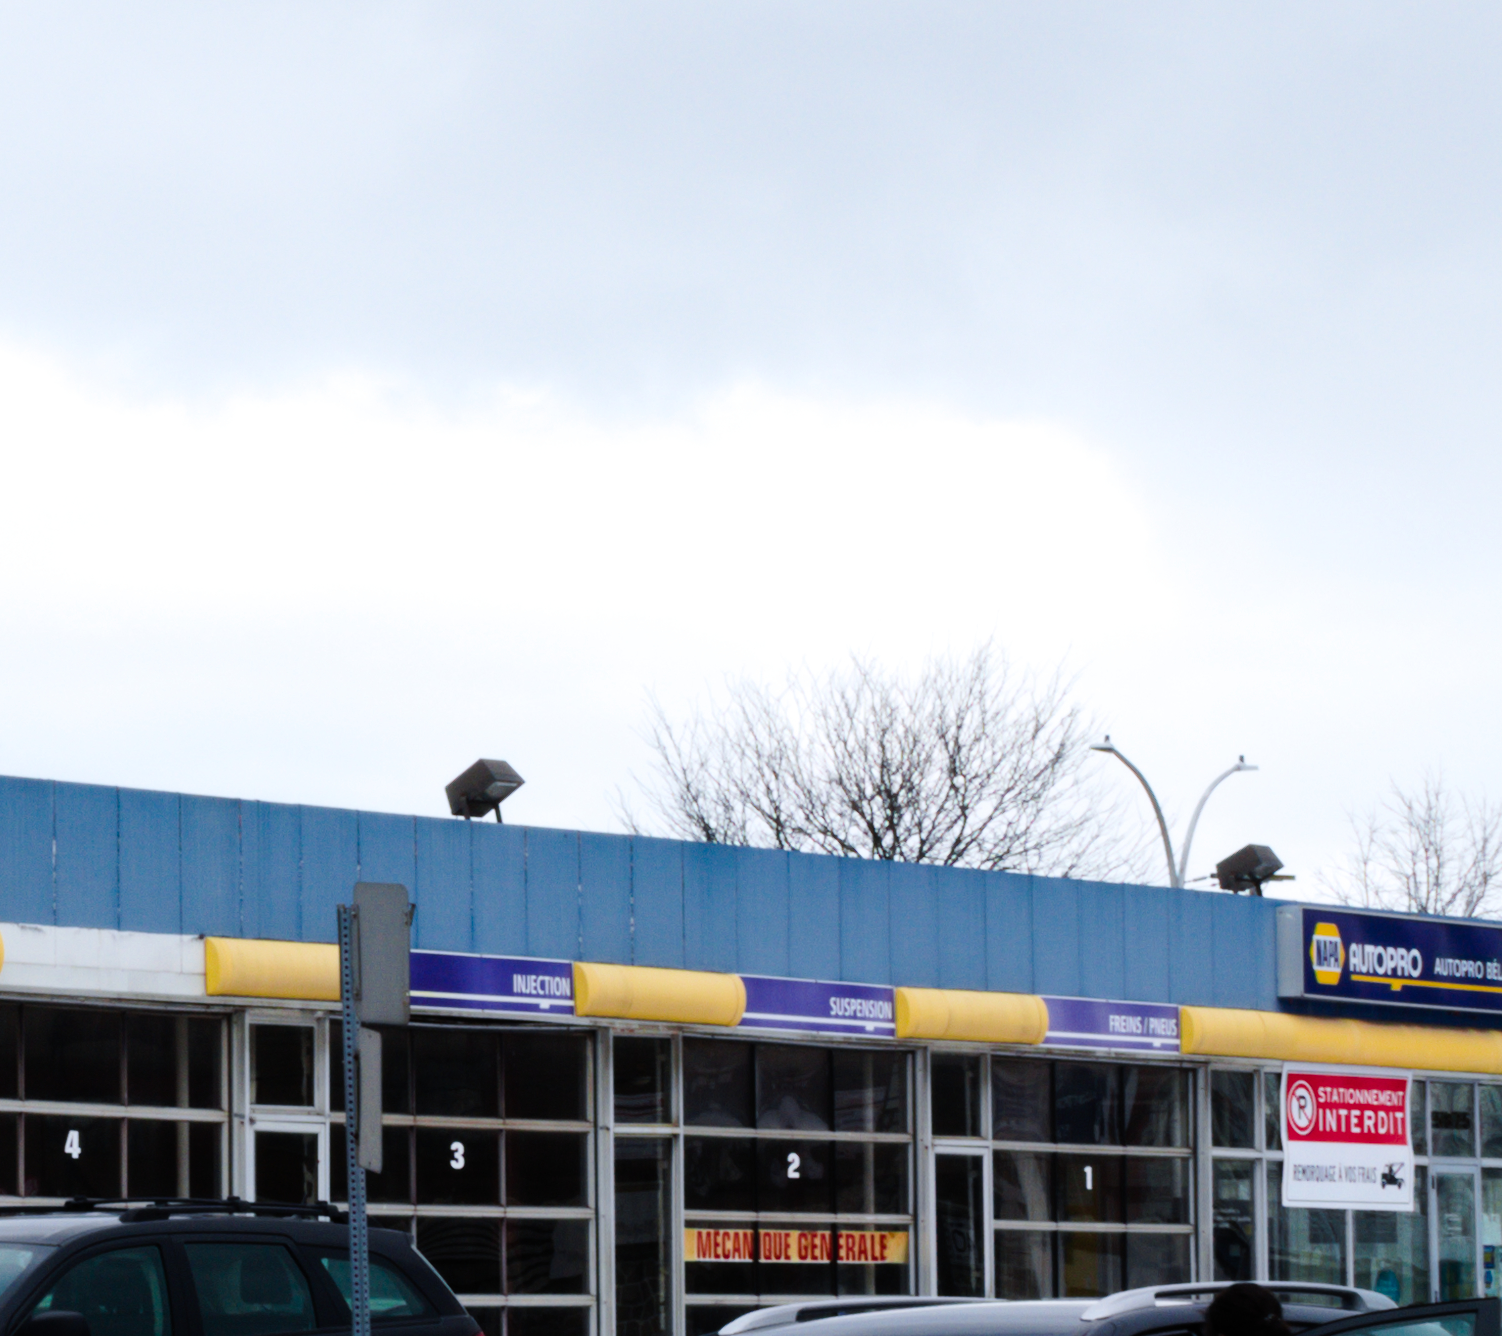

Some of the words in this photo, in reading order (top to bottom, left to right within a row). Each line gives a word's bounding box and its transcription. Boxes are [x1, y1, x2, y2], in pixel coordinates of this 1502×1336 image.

[1315, 938, 1342, 970] NAPA
[1349, 942, 1423, 979] AUTOPRO
[1434, 957, 1484, 980] AUTOPRO
[512, 972, 572, 999] INJECTION
[829, 996, 893, 1021] SUSPENSION
[1108, 1014, 1142, 1035] FREINS
[1148, 1016, 1179, 1038] PNEUS
[1317, 1086, 1405, 1107] STATIONNEMENT
[1318, 1108, 1405, 1136] INTERDIT
[63, 1129, 82, 1159] 4
[449, 1141, 466, 1170] 3
[786, 1152, 801, 1180] 2
[1083, 1165, 1094, 1191] 1
[1292, 1164, 1337, 1184] REMORQUAGE
[1344, 1165, 1357, 1183] VOS
[1357, 1166, 1377, 1184] FRAIS
